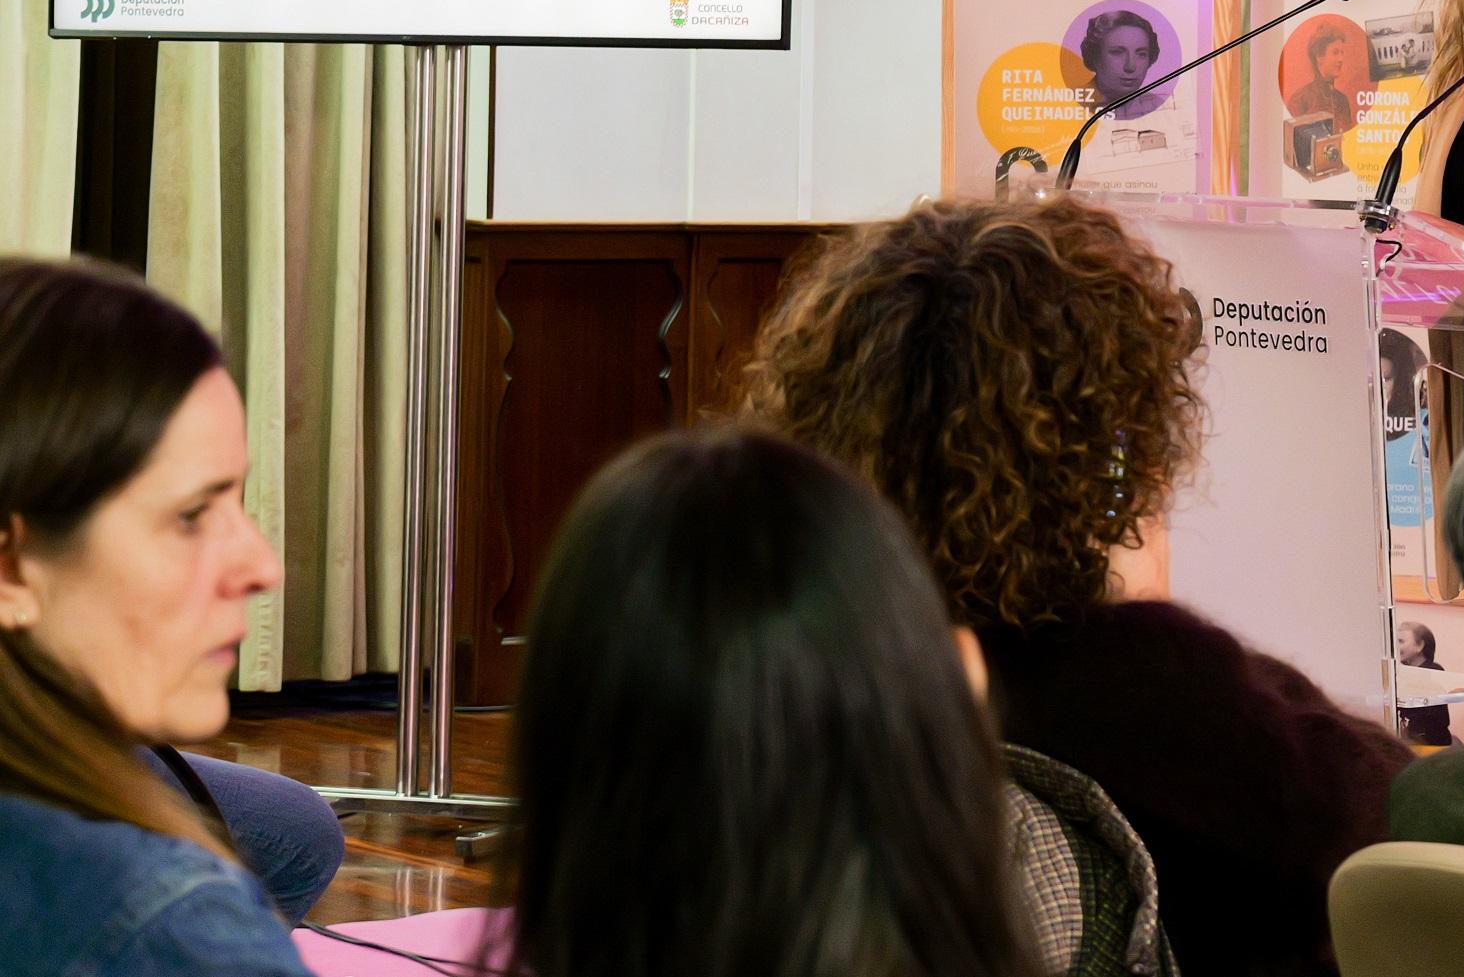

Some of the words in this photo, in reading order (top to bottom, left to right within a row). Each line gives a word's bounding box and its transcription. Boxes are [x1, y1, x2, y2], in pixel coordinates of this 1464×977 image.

[121, 6, 184, 16] Pontevedra
[1002, 70, 1043, 84] RITA
[1002, 86, 1095, 103] FERNÁNDEZ
[1357, 91, 1409, 106] CORONA
[1357, 128, 1409, 143] SANTO
[1213, 297, 1326, 326] Deputación
[1214, 326, 1328, 353] Pontevedra
